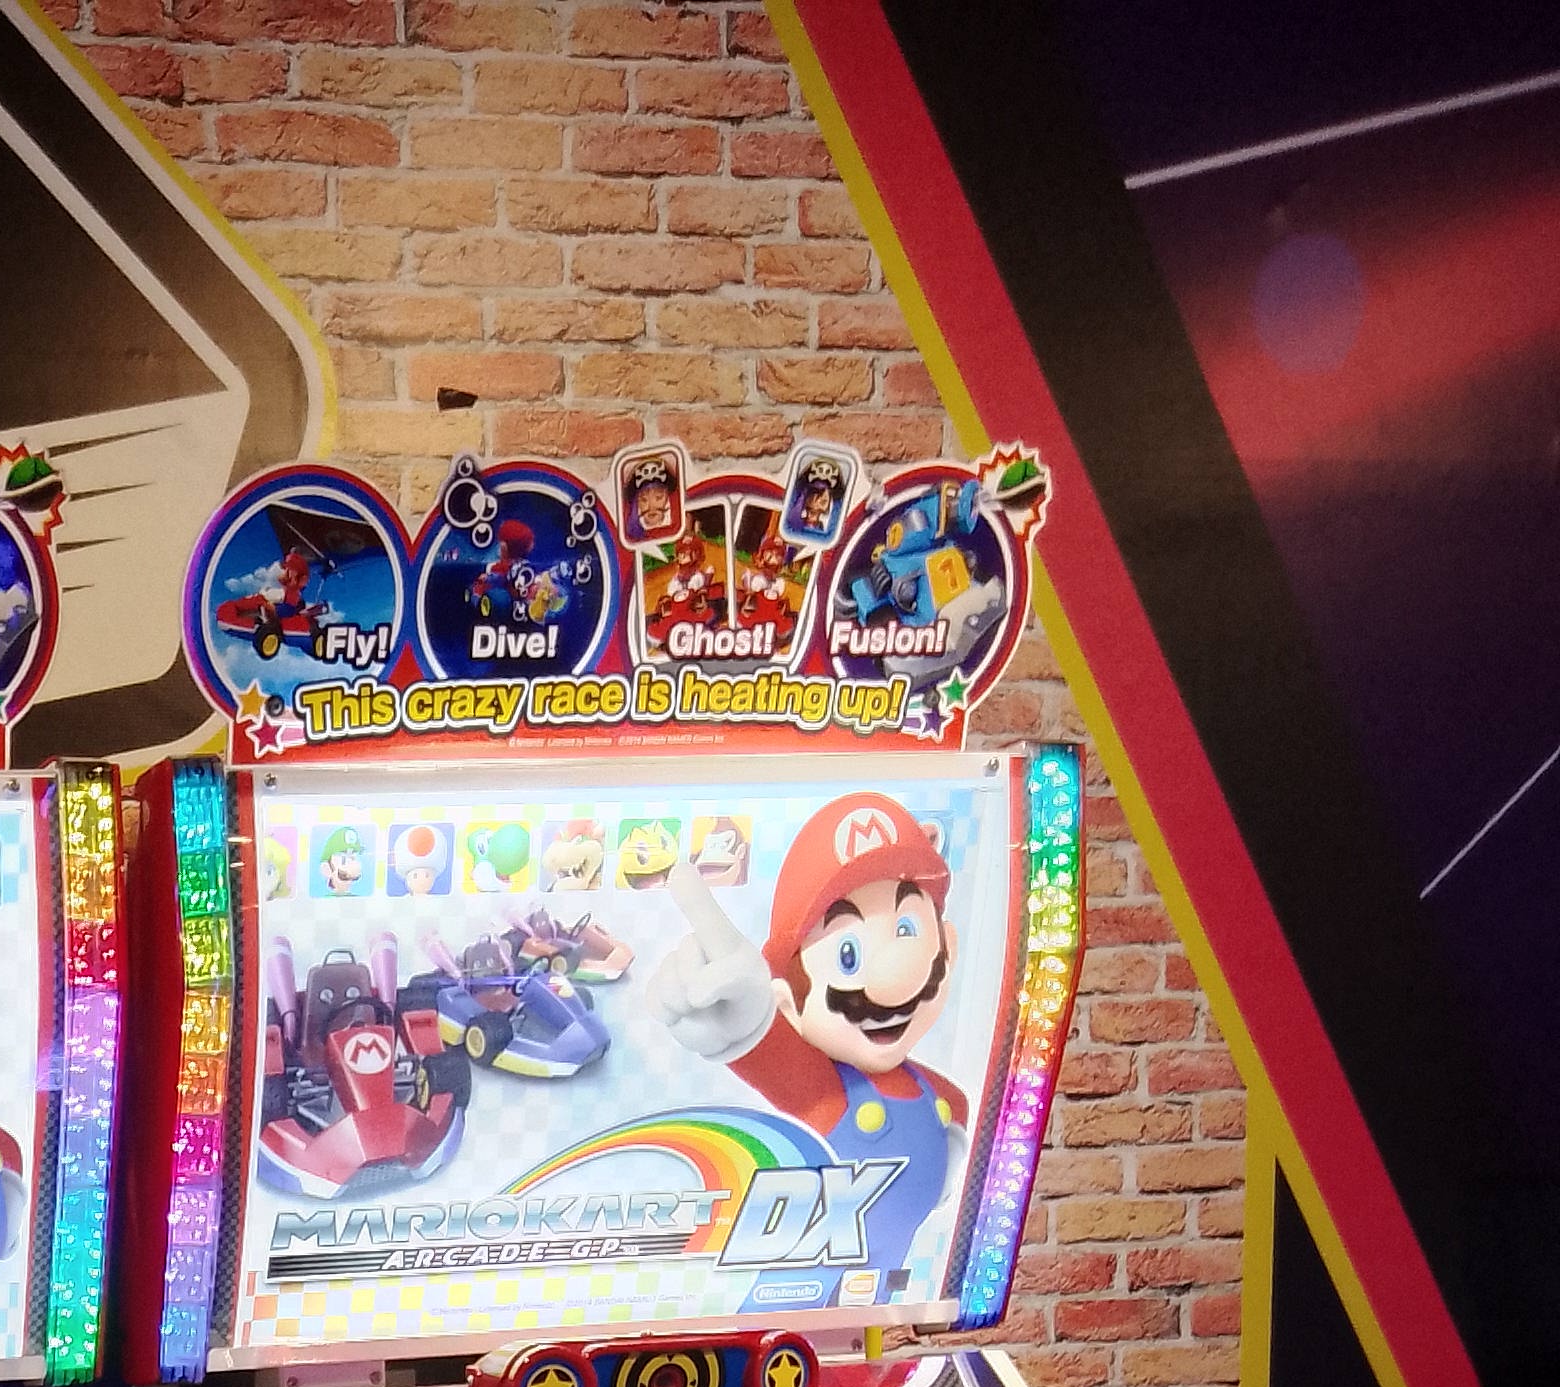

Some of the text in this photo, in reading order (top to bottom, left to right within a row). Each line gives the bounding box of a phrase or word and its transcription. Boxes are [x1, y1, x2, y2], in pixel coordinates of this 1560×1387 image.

[324, 622, 390, 661] Fly!
[470, 623, 558, 660] Dive!
[668, 622, 775, 658] Ghost!
[831, 620, 945, 656] Fusion!
[302, 671, 905, 732] This crazy race is heating up!
[720, 1158, 908, 1268] DX
[383, 1237, 619, 1271] ARCADE GP
[760, 1285, 817, 1299] Nintendo
